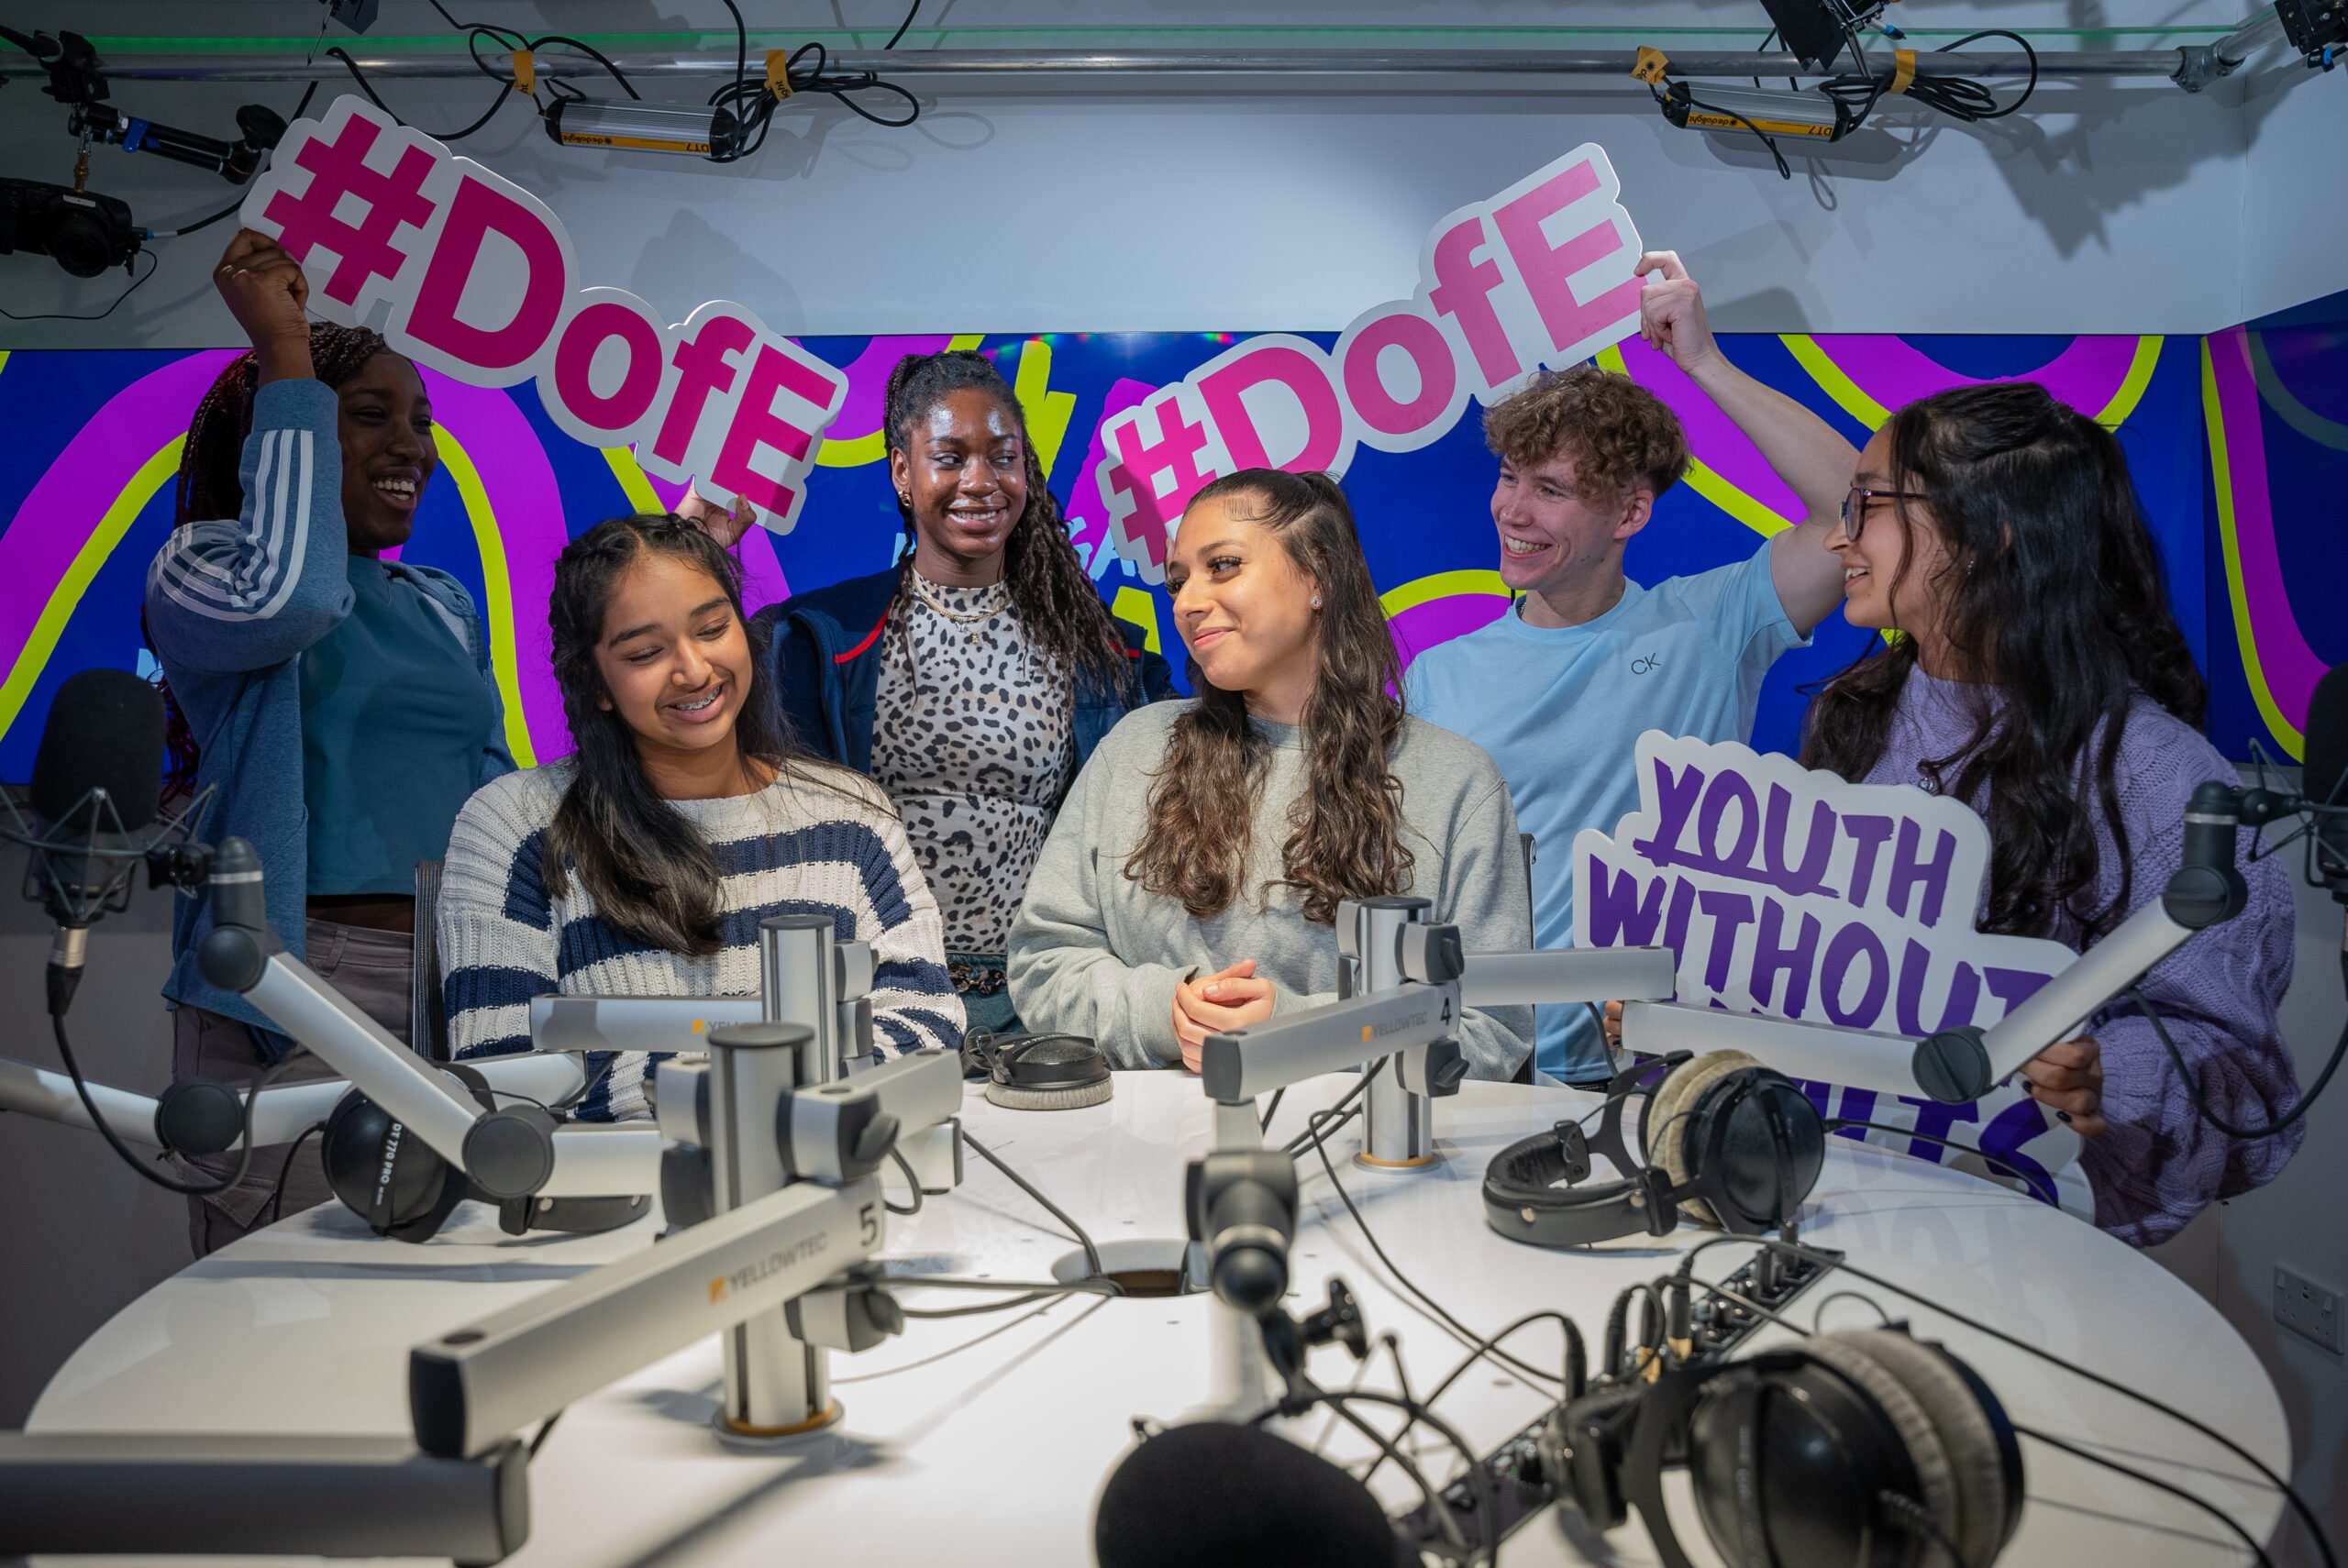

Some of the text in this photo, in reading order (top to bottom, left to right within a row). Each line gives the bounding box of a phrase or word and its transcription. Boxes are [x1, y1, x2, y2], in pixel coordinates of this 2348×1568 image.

[1689, 115, 1729, 127] dedolight
[1808, 125, 1833, 137] DT7
[562, 132, 604, 145] dedolight
[686, 142, 710, 153] DT7
[264, 114, 836, 517] #DofE
[1108, 159, 1648, 570] #DofE
[1631, 652, 1662, 675] CK
[1633, 756, 1956, 928] YOUTH
[1374, 1011, 1428, 1037] YELLOWTEC
[1440, 997, 1452, 1026] 4
[381, 1123, 402, 1184] DT 770 PRO
[859, 1200, 878, 1248] 5
[730, 1232, 827, 1287] YELLOWTEC
